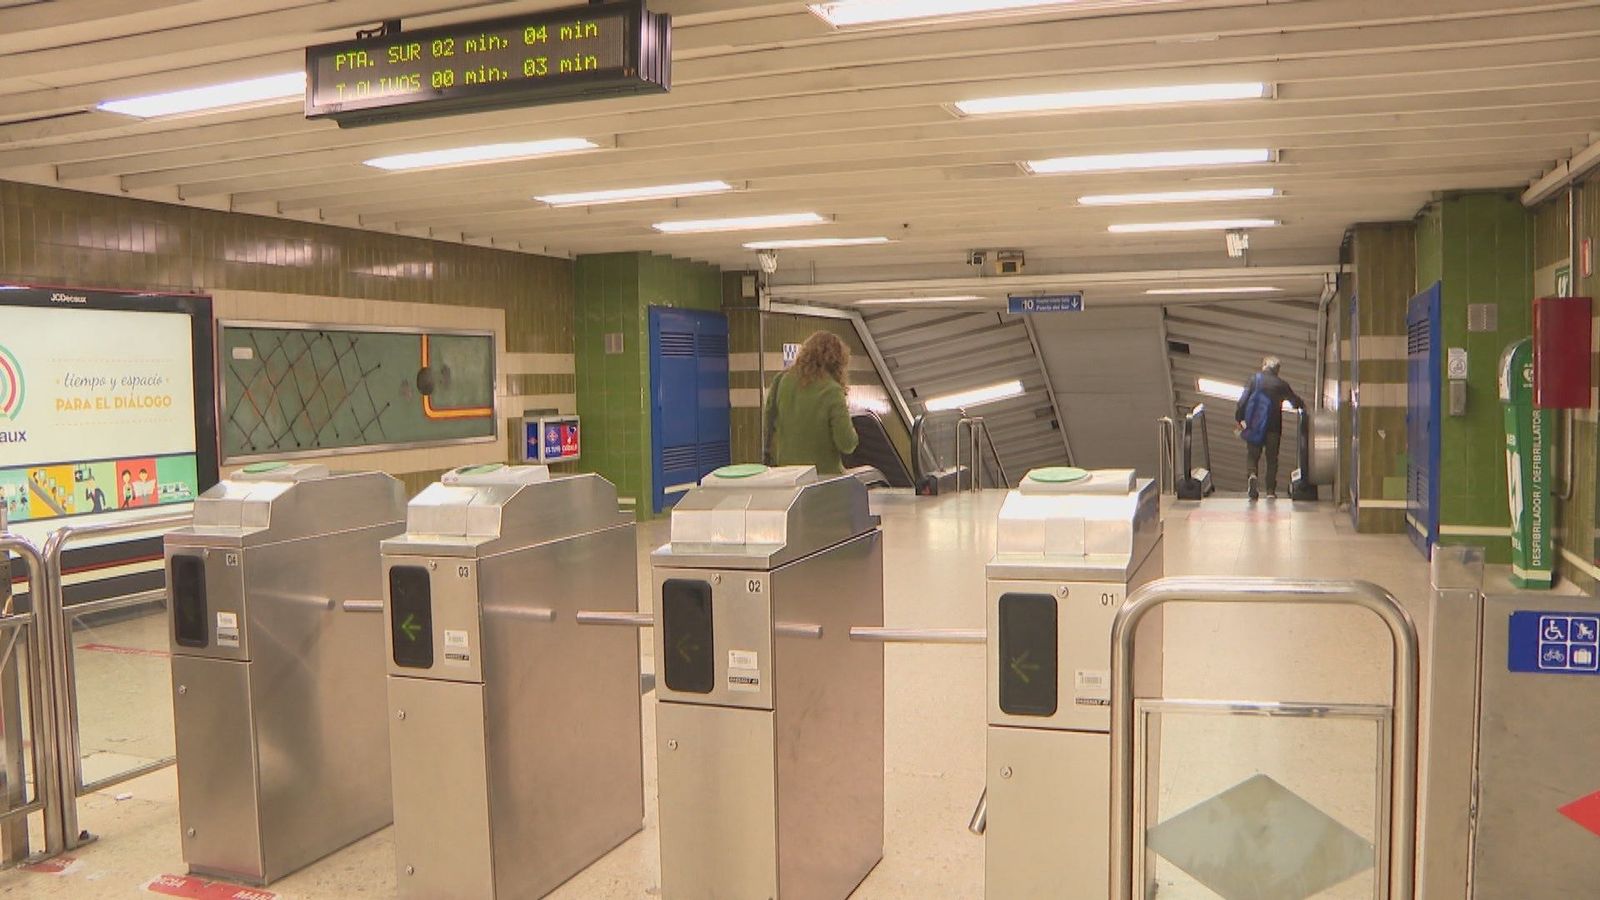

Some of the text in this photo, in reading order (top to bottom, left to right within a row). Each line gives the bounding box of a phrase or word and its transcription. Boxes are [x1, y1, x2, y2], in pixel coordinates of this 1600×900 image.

[335, 20, 598, 72] PTA. SUR 02 min, 04 min
[432, 69, 455, 89] 00
[464, 65, 509, 85] min,
[524, 57, 548, 77] 03
[560, 52, 598, 73] min
[50, 293, 87, 303] JCDecaux
[1023, 299, 1034, 310] 10
[64, 372, 163, 391] tiempo y espacio
[56, 393, 172, 411] PARA EL DIÁLOGO
[1532, 410, 1542, 482] DEFIBRILLATOR
[1532, 492, 1542, 566] DESFIBRILADOR
[227, 555, 236, 565] 04
[458, 566, 469, 578] 03
[748, 580, 761, 593] 02
[1101, 593, 1114, 606] 01
